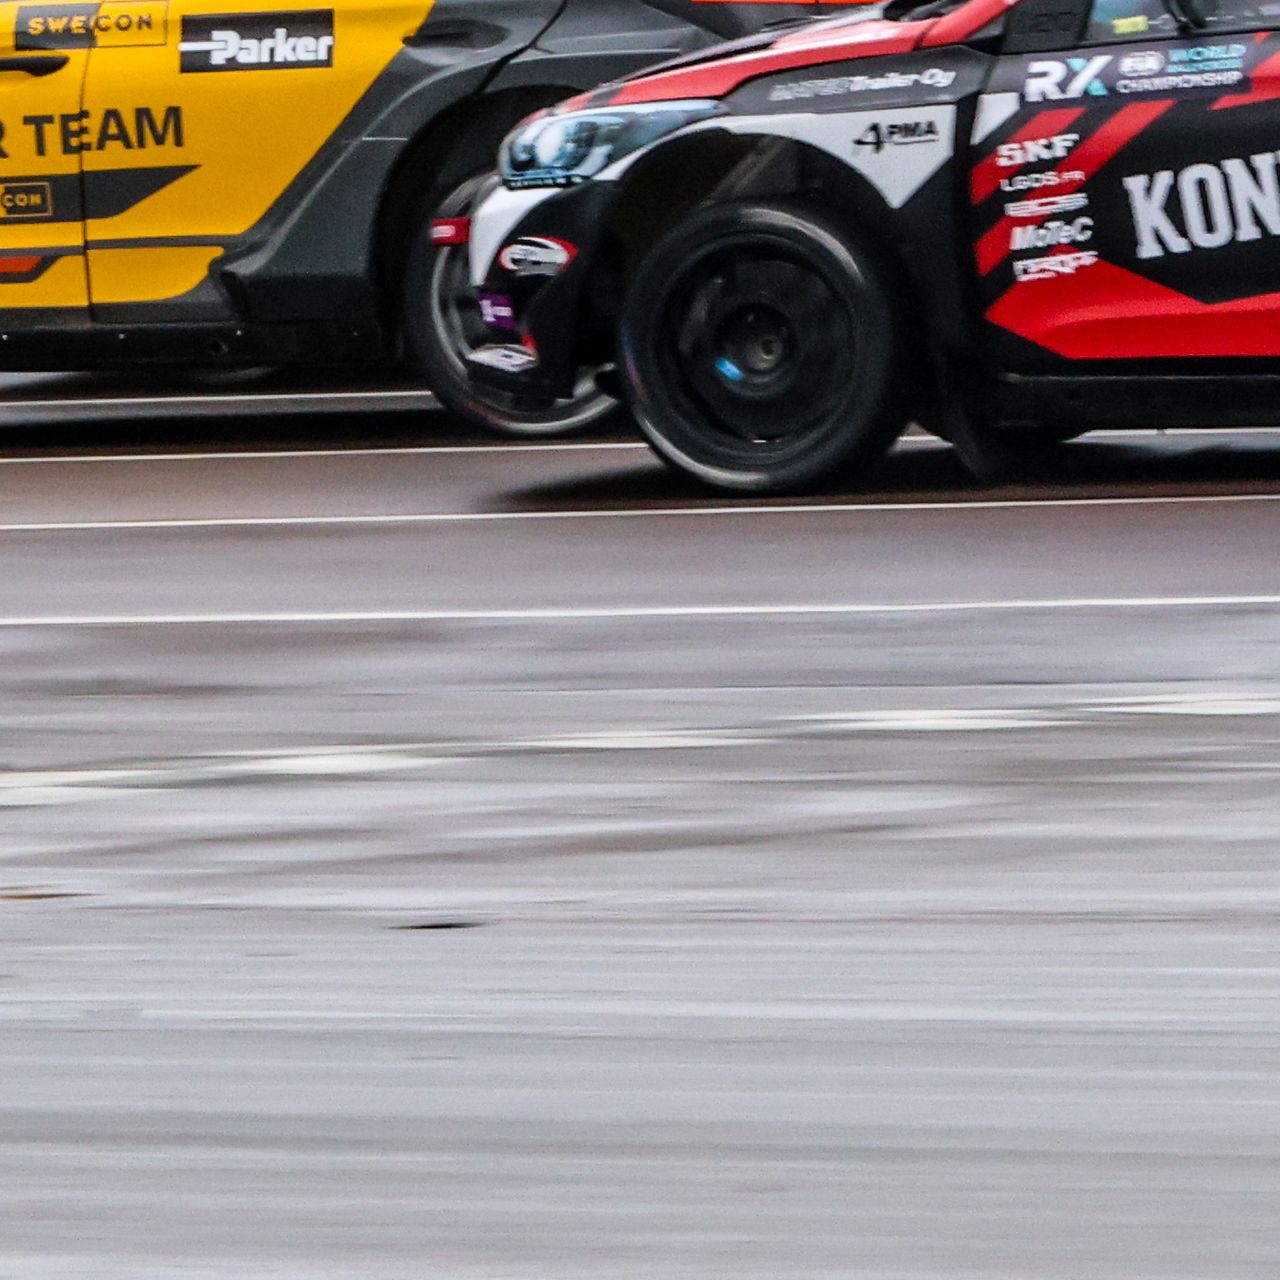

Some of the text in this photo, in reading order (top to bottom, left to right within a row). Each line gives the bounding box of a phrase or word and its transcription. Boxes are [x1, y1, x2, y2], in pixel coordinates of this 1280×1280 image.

[27, 14, 153, 36] SWECON
[208, 27, 333, 65] Parker
[1024, 54, 1114, 102] RX
[1116, 71, 1243, 93] CHAMPIONSHIP
[23, 106, 184, 156] TEAM
[995, 133, 1080, 167] SKF
